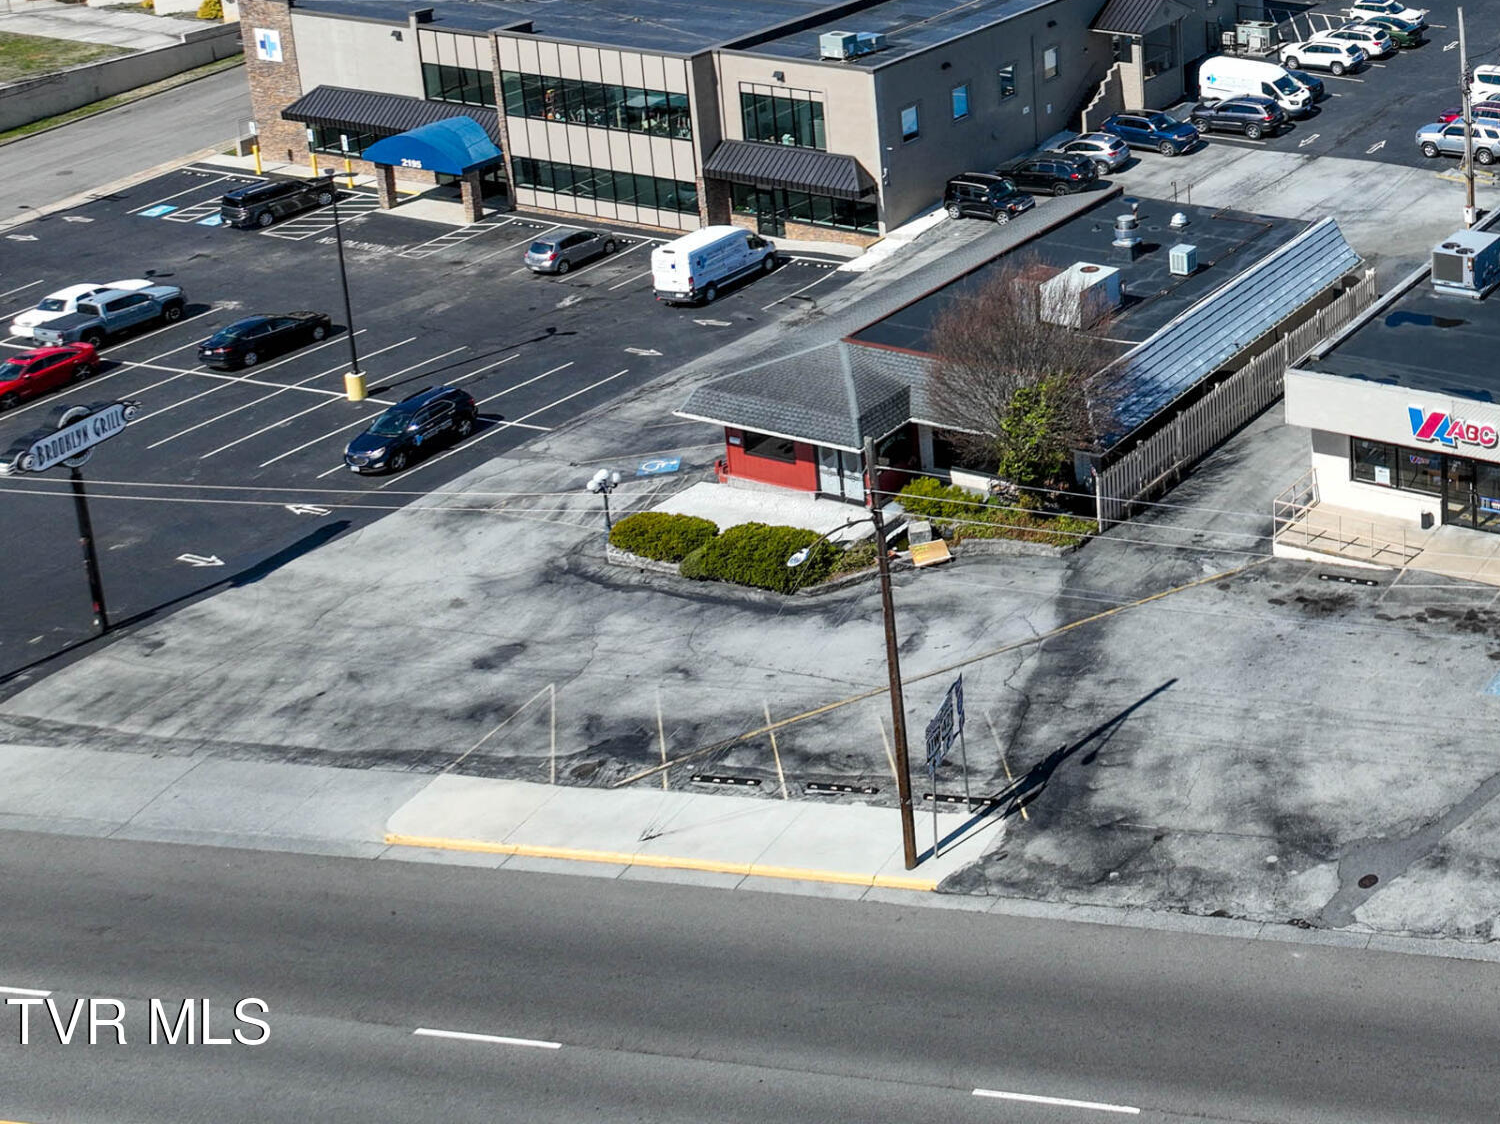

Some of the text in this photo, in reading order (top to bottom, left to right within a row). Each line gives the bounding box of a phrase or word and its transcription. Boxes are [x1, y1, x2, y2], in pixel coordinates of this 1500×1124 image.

[36, 410, 121, 467] BROOKLYN GRILL
[1446, 420, 1496, 445] ABC
